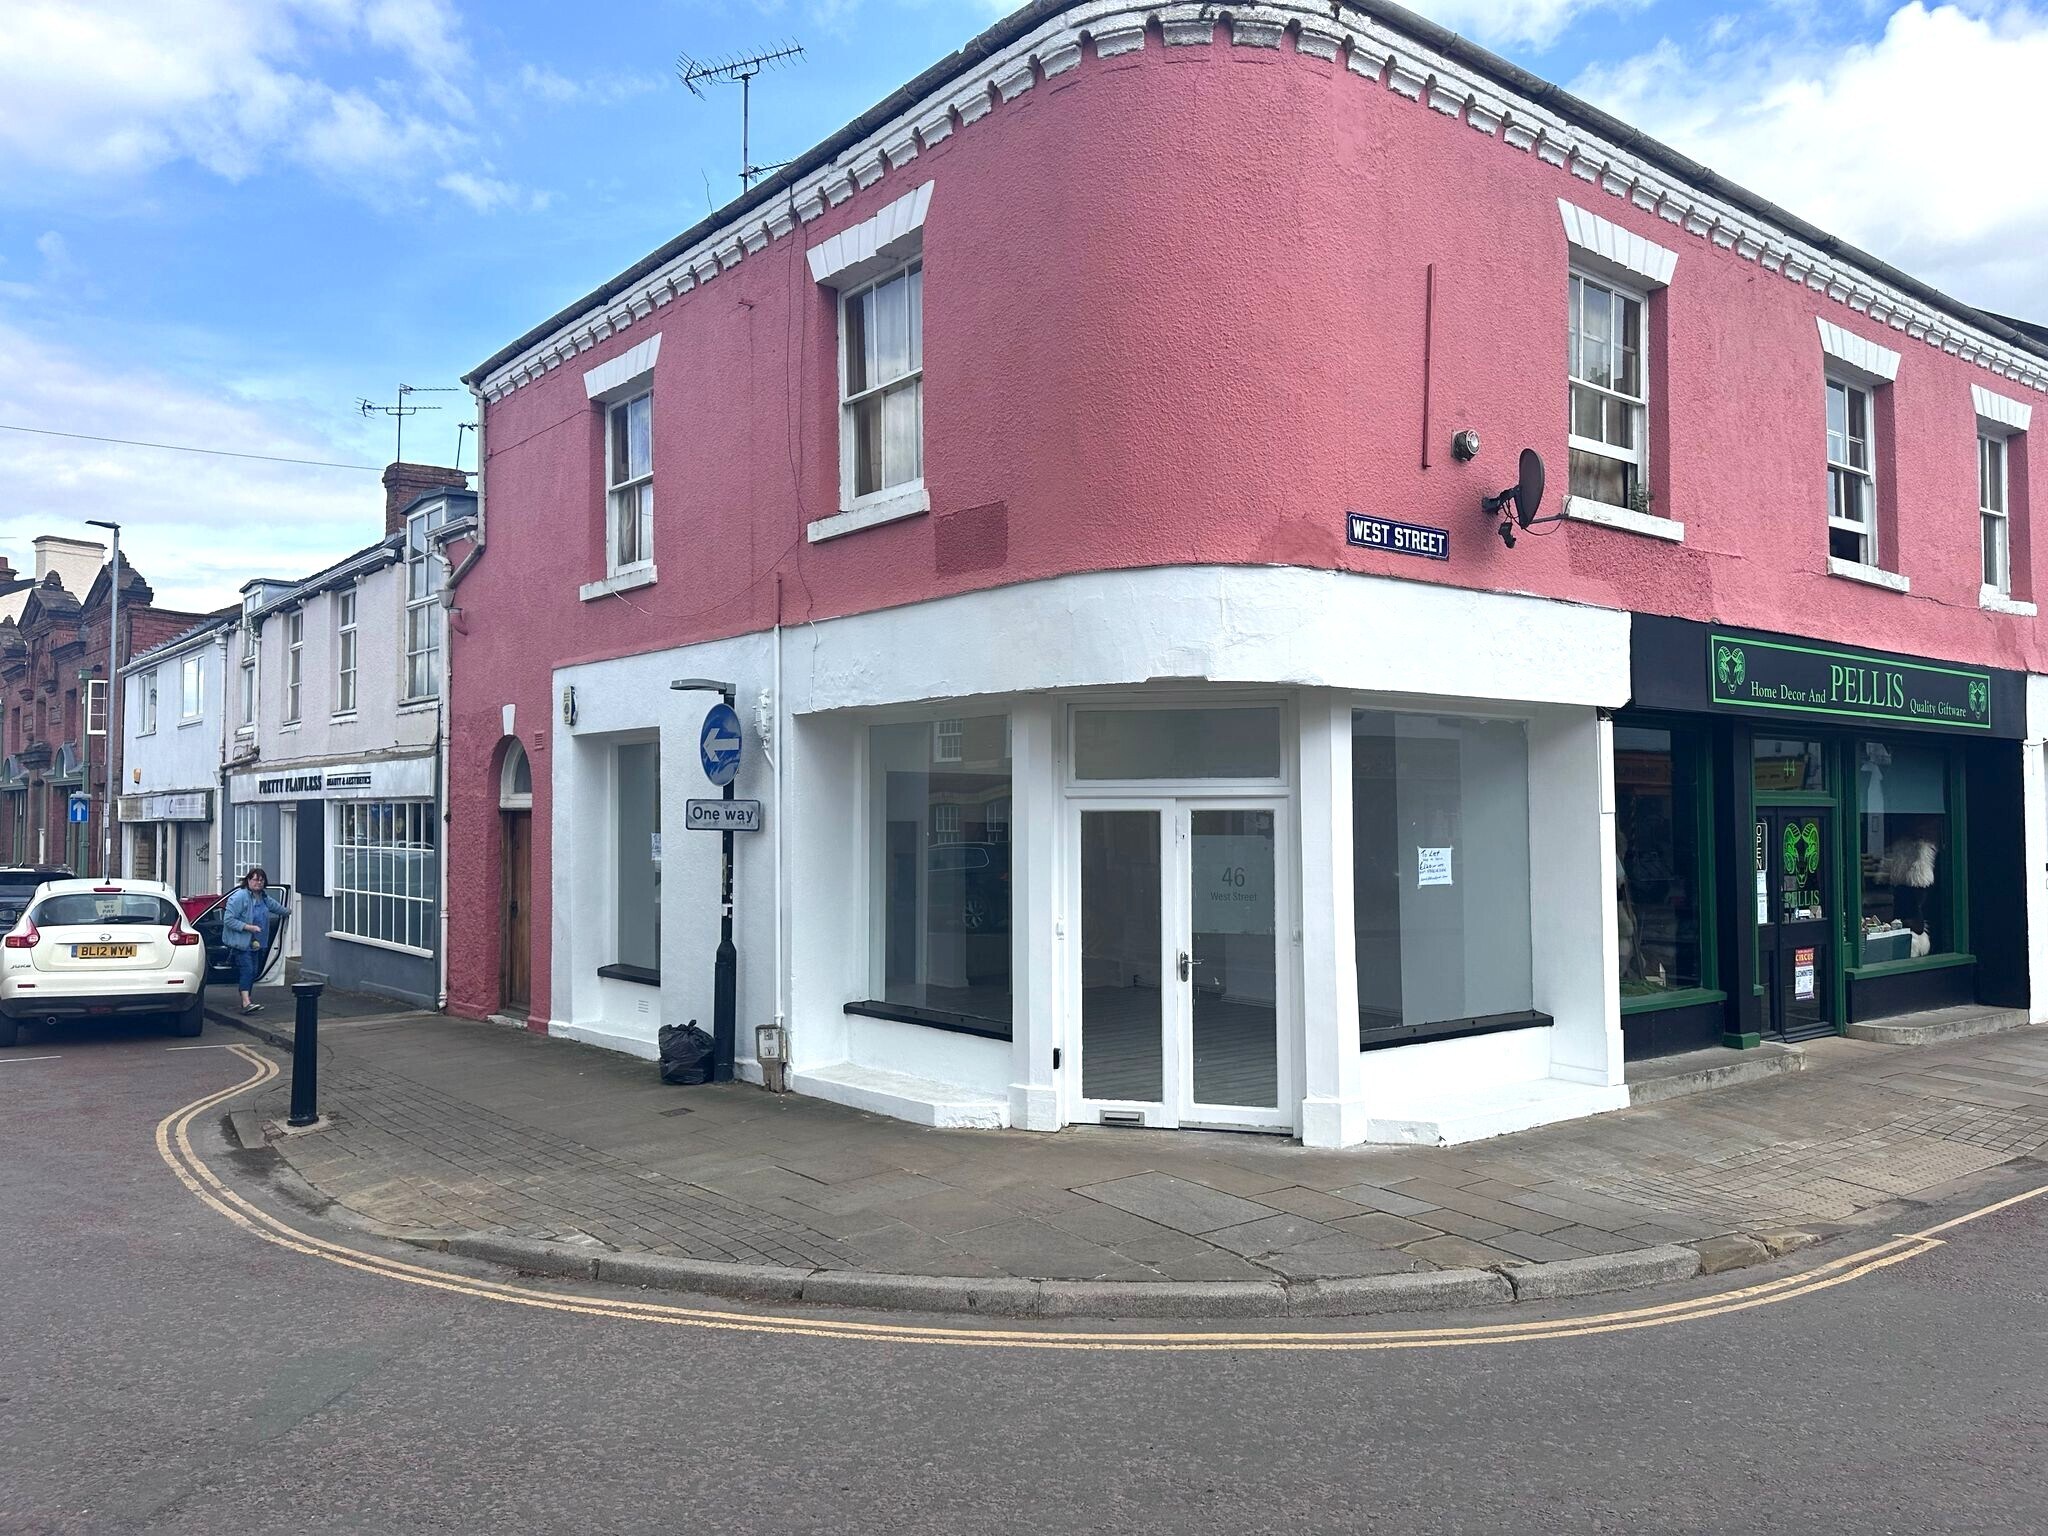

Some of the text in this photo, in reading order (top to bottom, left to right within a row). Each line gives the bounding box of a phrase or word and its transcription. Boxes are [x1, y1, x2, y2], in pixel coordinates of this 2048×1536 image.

[1352, 519, 1445, 554] WEST STREET
[1751, 681, 1826, 704] Home Decor And
[1830, 664, 1904, 709] PELLIS
[1909, 698, 1967, 718] Quality Giftware
[1783, 759, 1796, 777] 44
[259, 775, 322, 794] PRETTY FLAWLESS
[692, 806, 754, 824] One way
[1222, 867, 1245, 887] 46
[1210, 891, 1257, 901] West Street
[1784, 890, 1820, 907] PELLIS
[81, 946, 133, 956] BL12 WYM
[1795, 953, 1814, 962] CIRCUS
